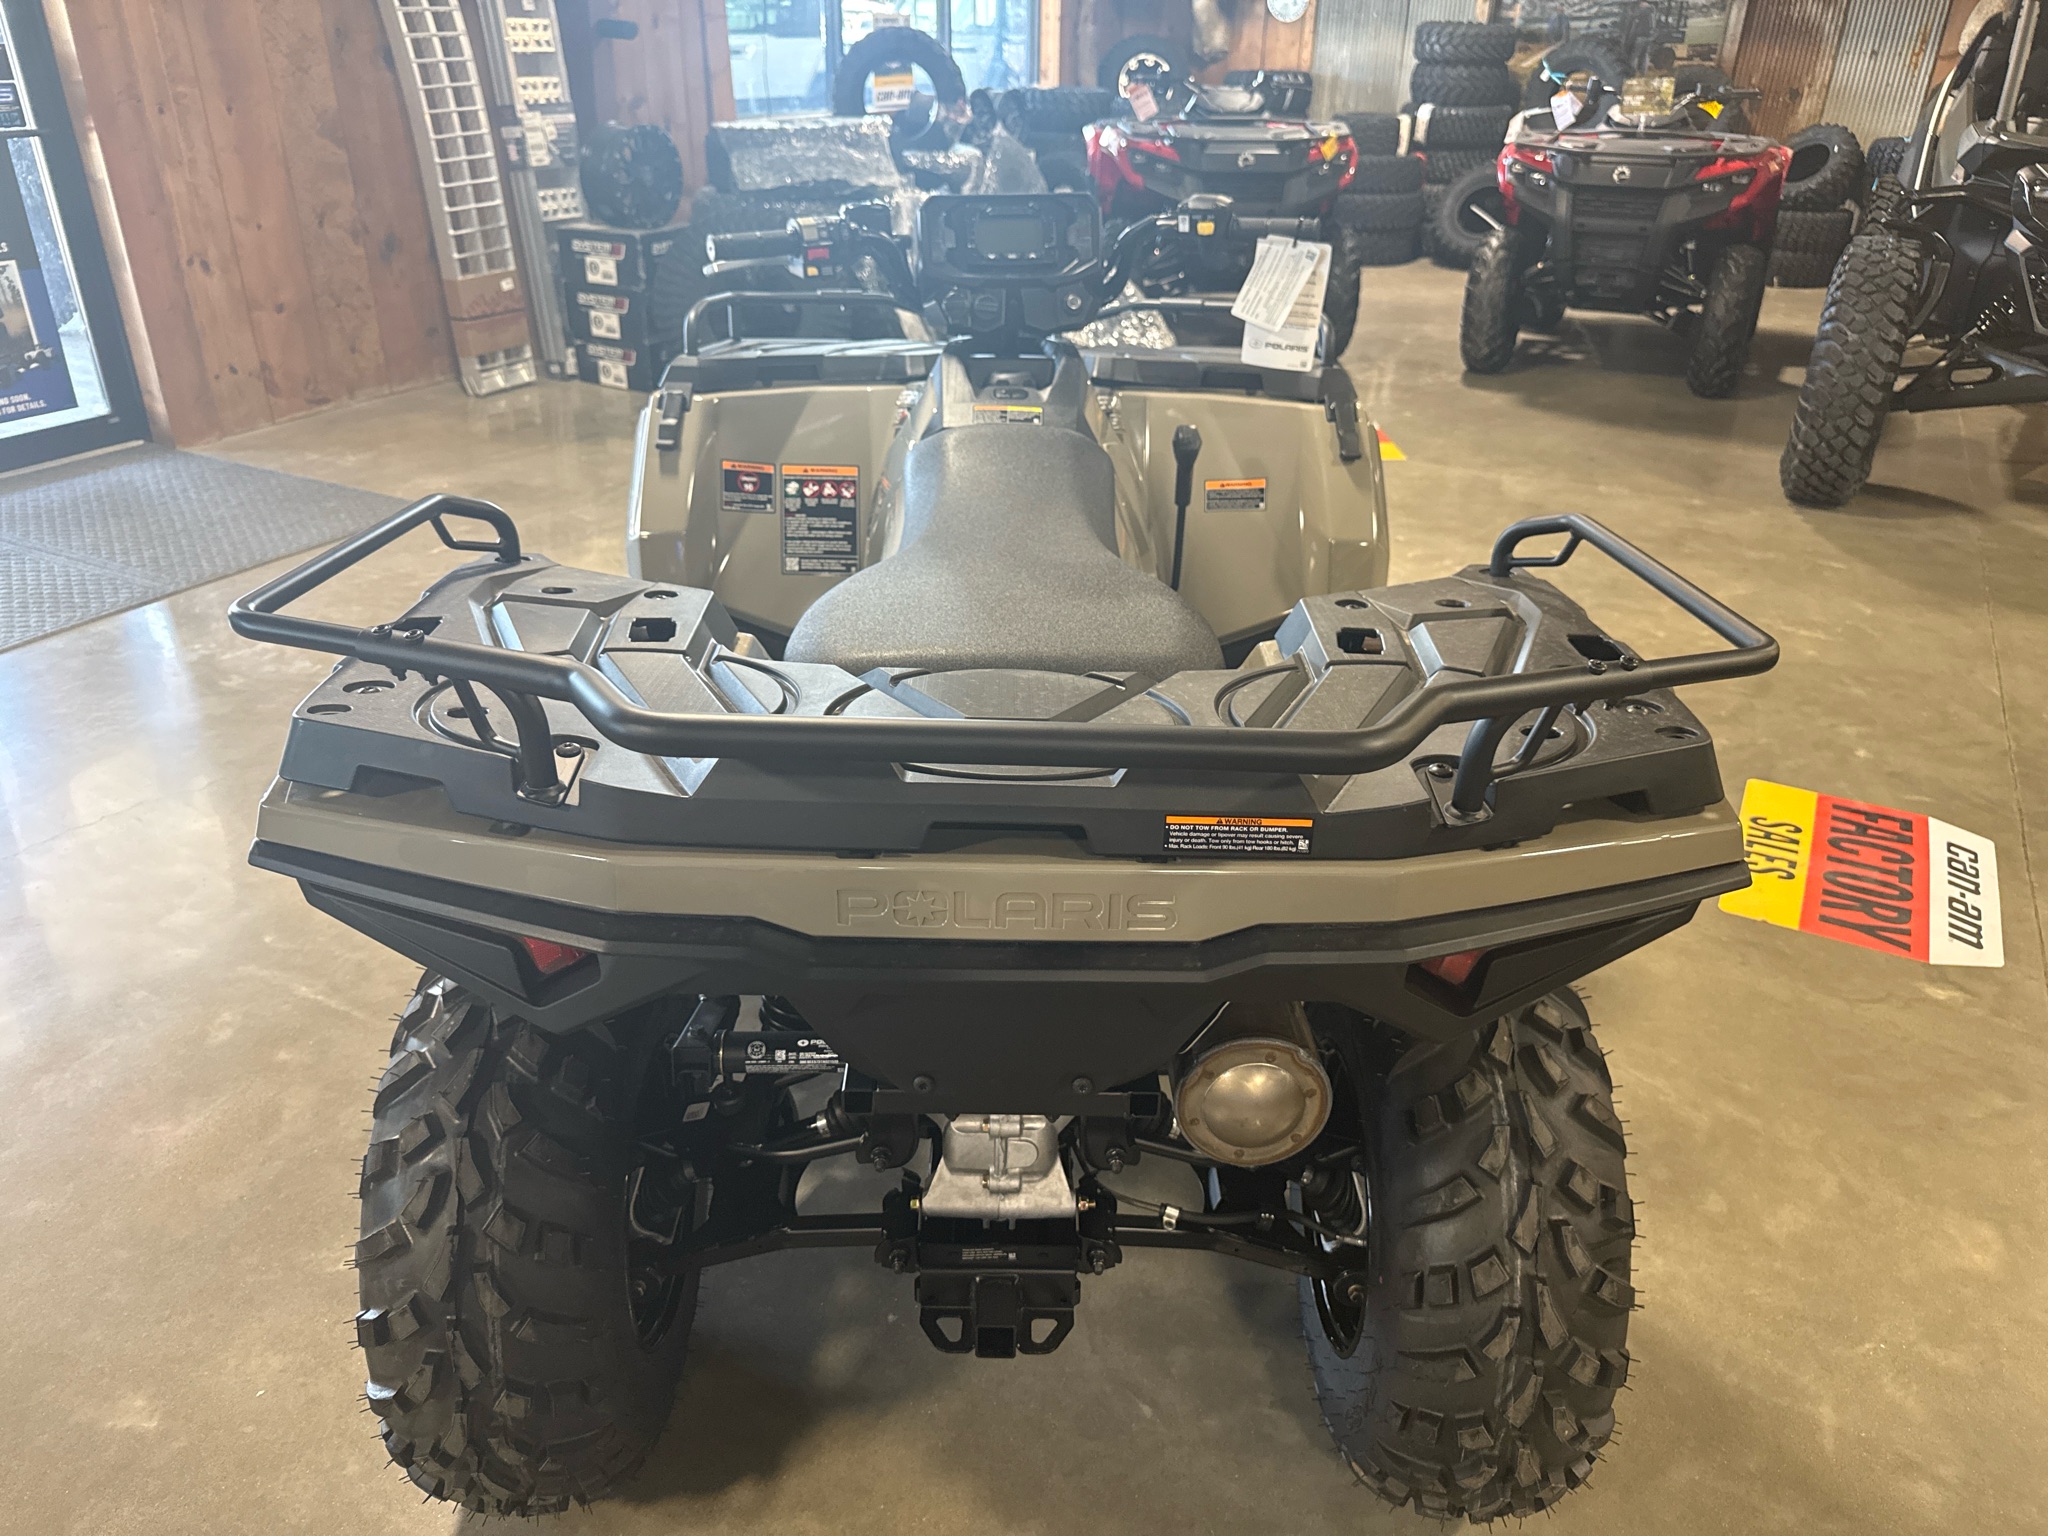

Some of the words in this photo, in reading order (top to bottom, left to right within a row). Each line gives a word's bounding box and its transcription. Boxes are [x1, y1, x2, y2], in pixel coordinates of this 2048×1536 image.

[1264, 342, 1309, 353] POLARIS
[17, 399, 47, 412] DETAILS.
[1744, 816, 1803, 880] SALES
[1817, 803, 1915, 952] FACTORY
[1946, 841, 1984, 950] can-am
[836, 889, 1179, 931] POLARIS
